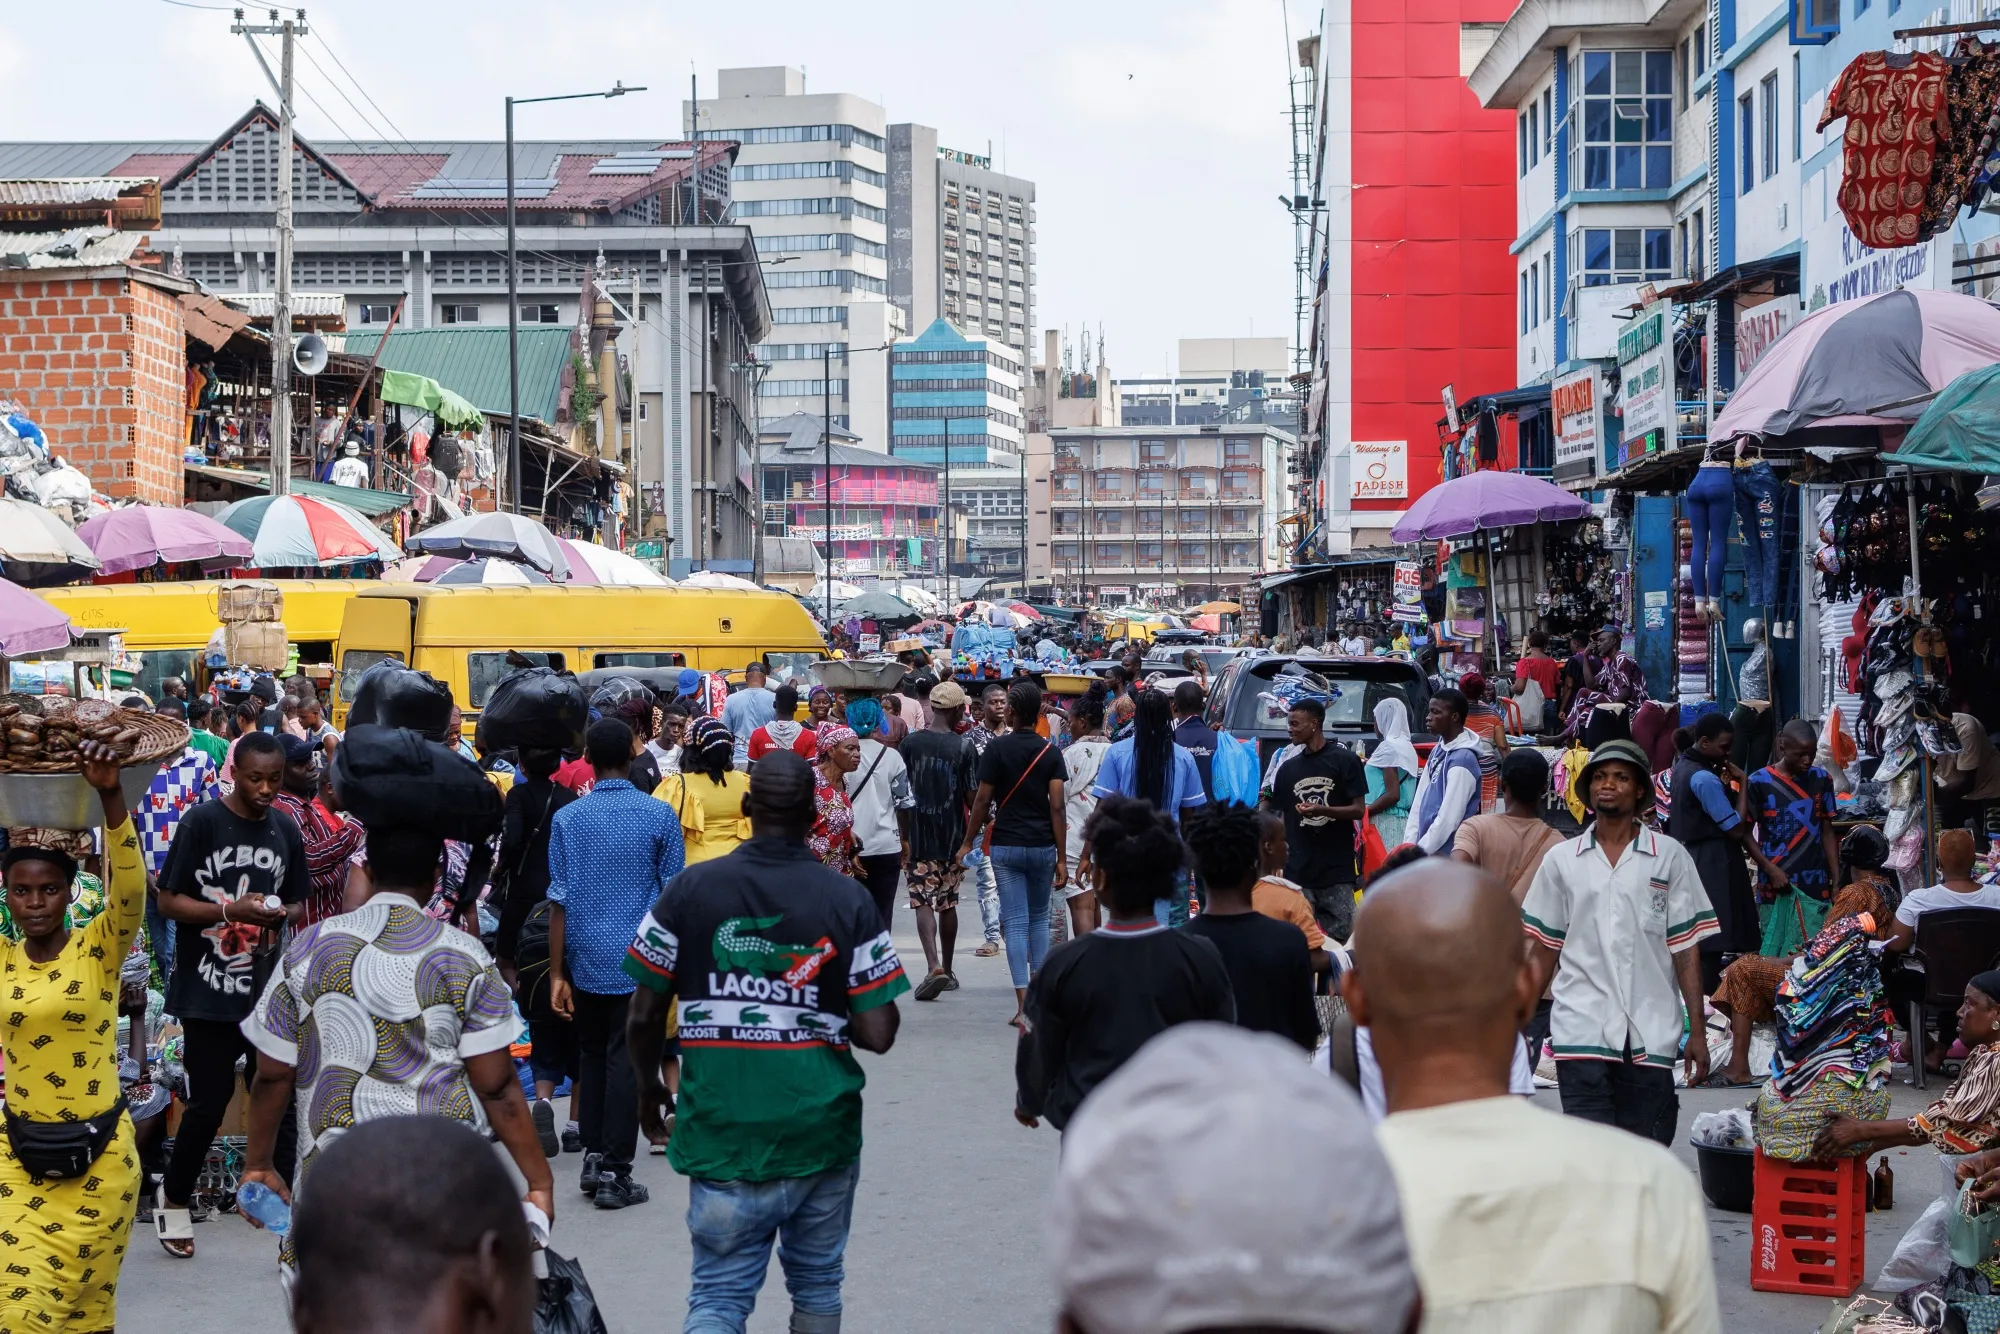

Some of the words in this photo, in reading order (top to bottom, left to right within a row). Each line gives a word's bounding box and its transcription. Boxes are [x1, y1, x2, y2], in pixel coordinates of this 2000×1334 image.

[1356, 445, 1390, 453] Welcome
[1393, 445, 1401, 453] to
[1354, 481, 1403, 497] JADESH
[622, 542, 661, 560] et9ja
[1395, 569, 1420, 585] POS
[633, 937, 676, 971] LACOSTE
[709, 972, 819, 1008] LACOSTE
[679, 1026, 720, 1039] LACOSTE
[732, 1028, 782, 1041] LACOSTE
[1762, 1225, 1776, 1272] Coca-Cola
